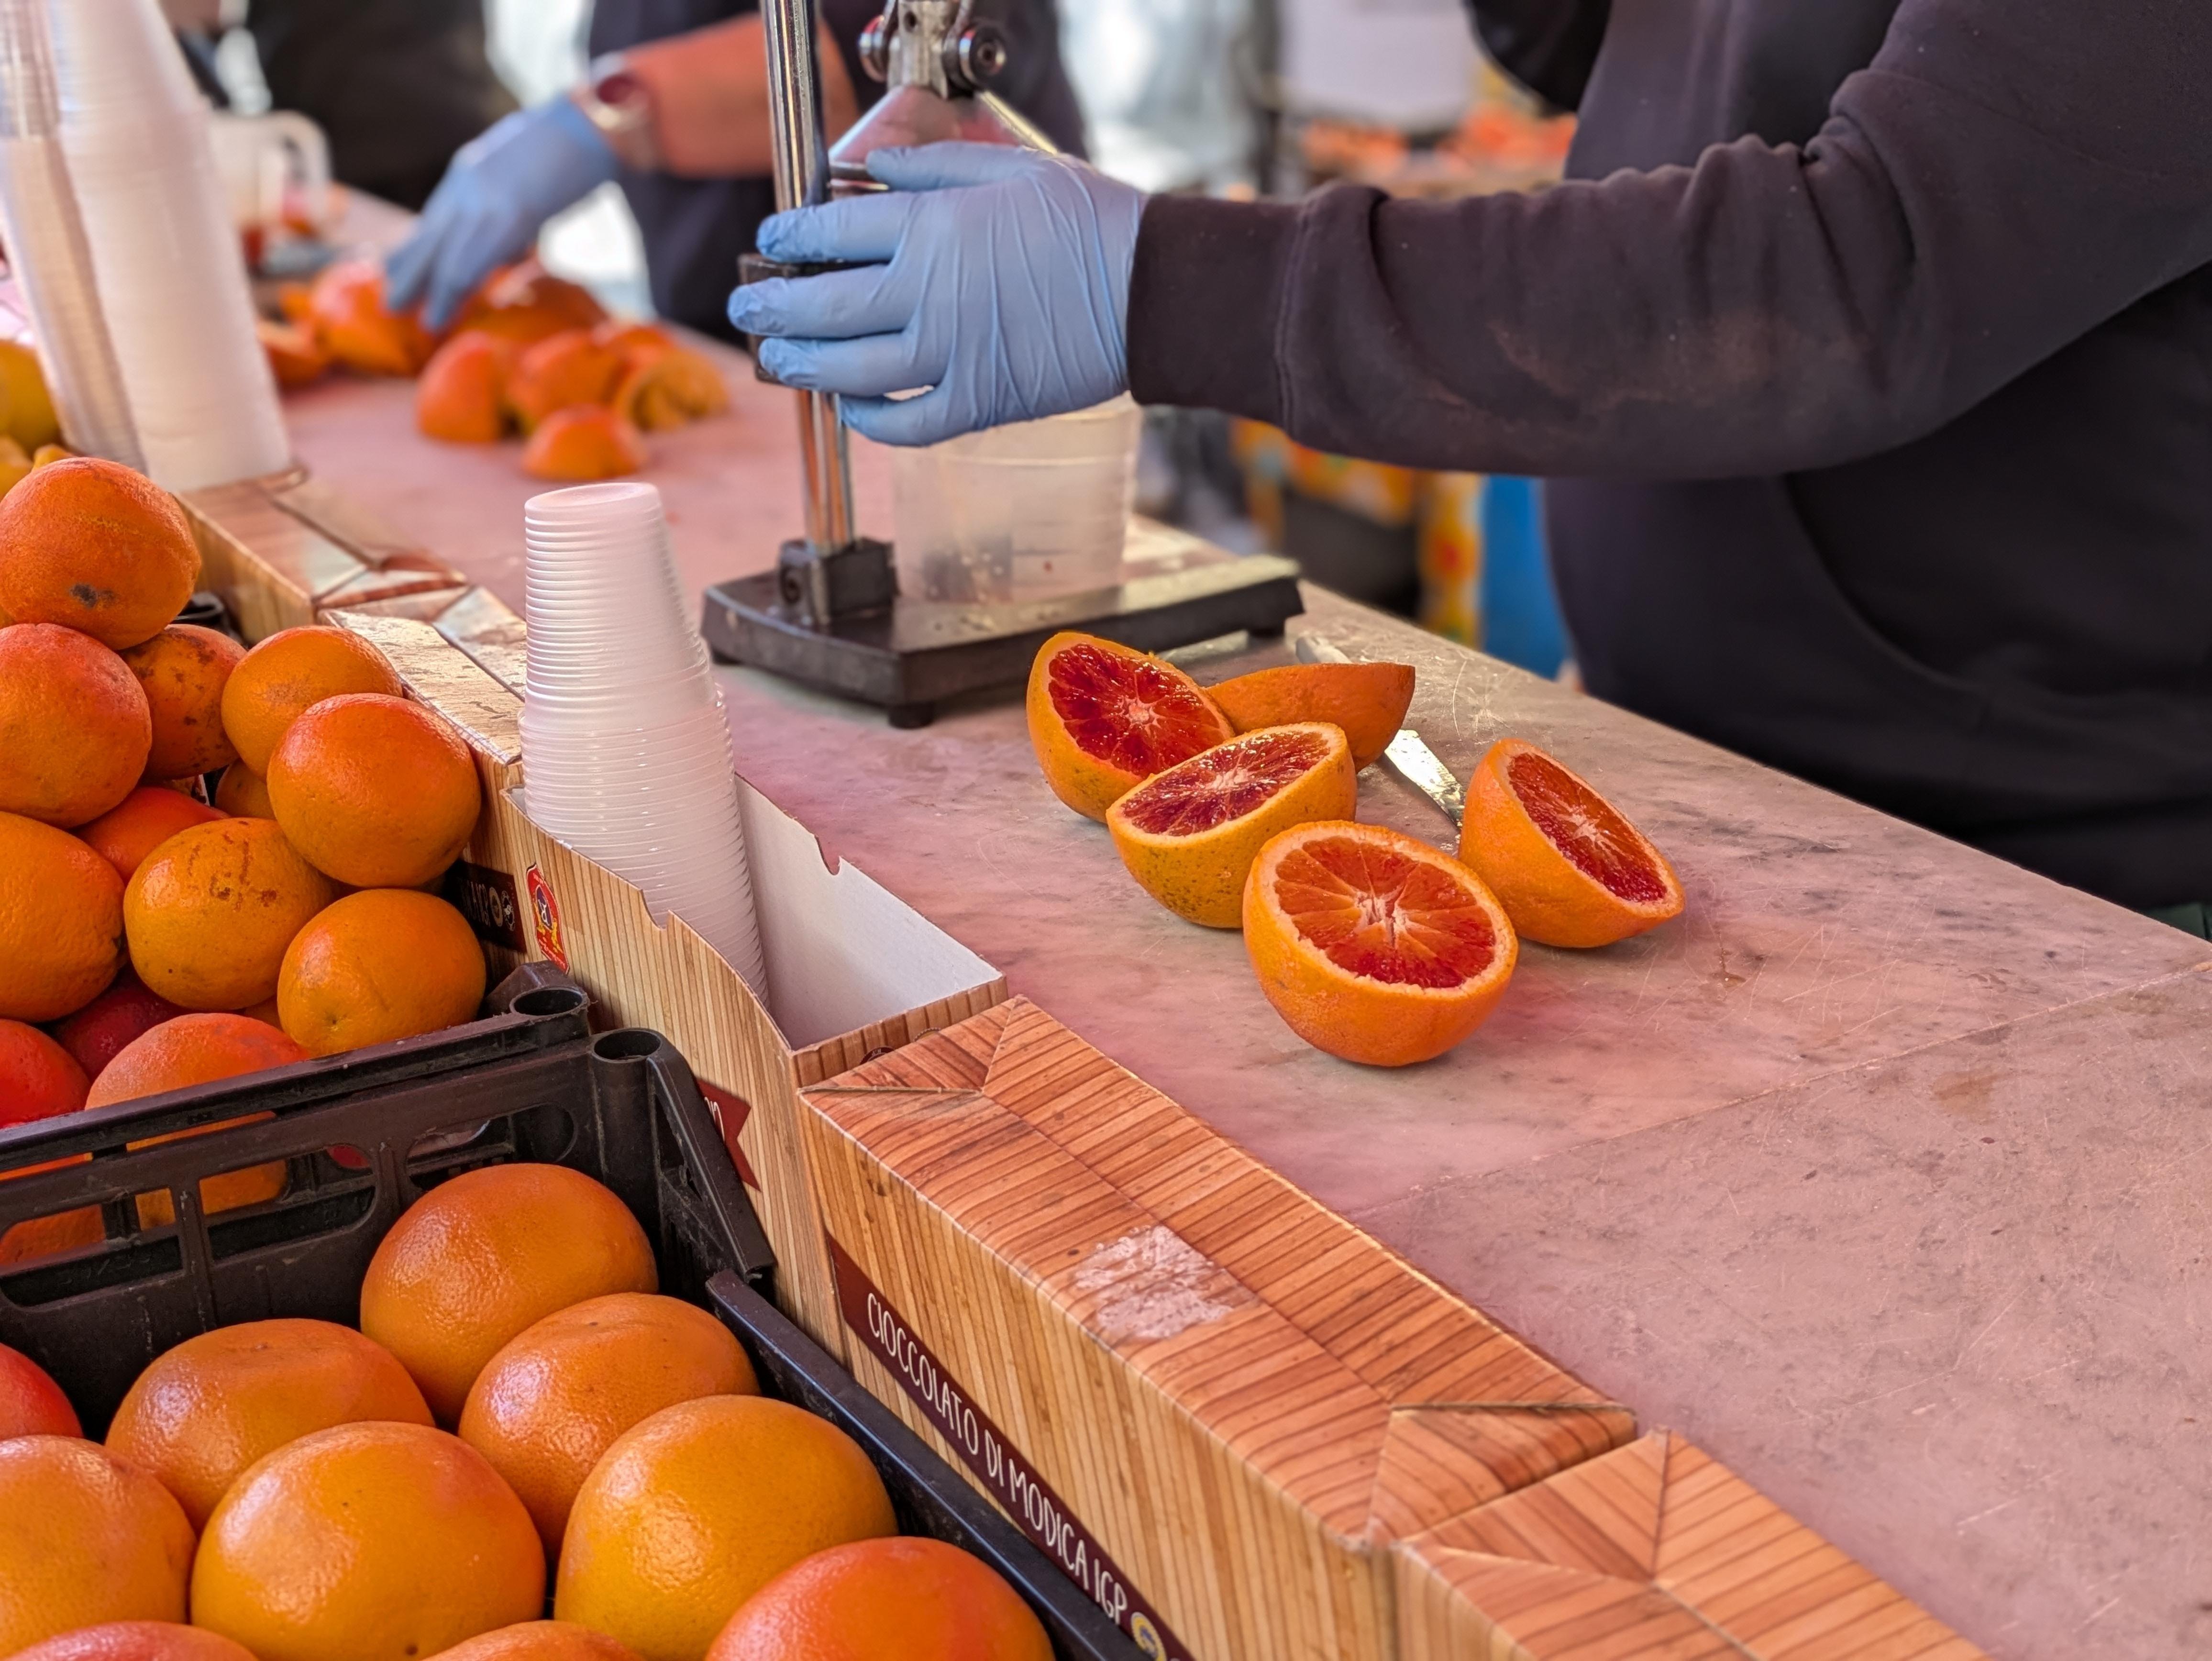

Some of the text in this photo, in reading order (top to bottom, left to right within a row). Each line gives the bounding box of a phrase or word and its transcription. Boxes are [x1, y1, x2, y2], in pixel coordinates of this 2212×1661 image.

[867, 1293, 1128, 1625] CIOCCOLATO DI MODICA IGP
